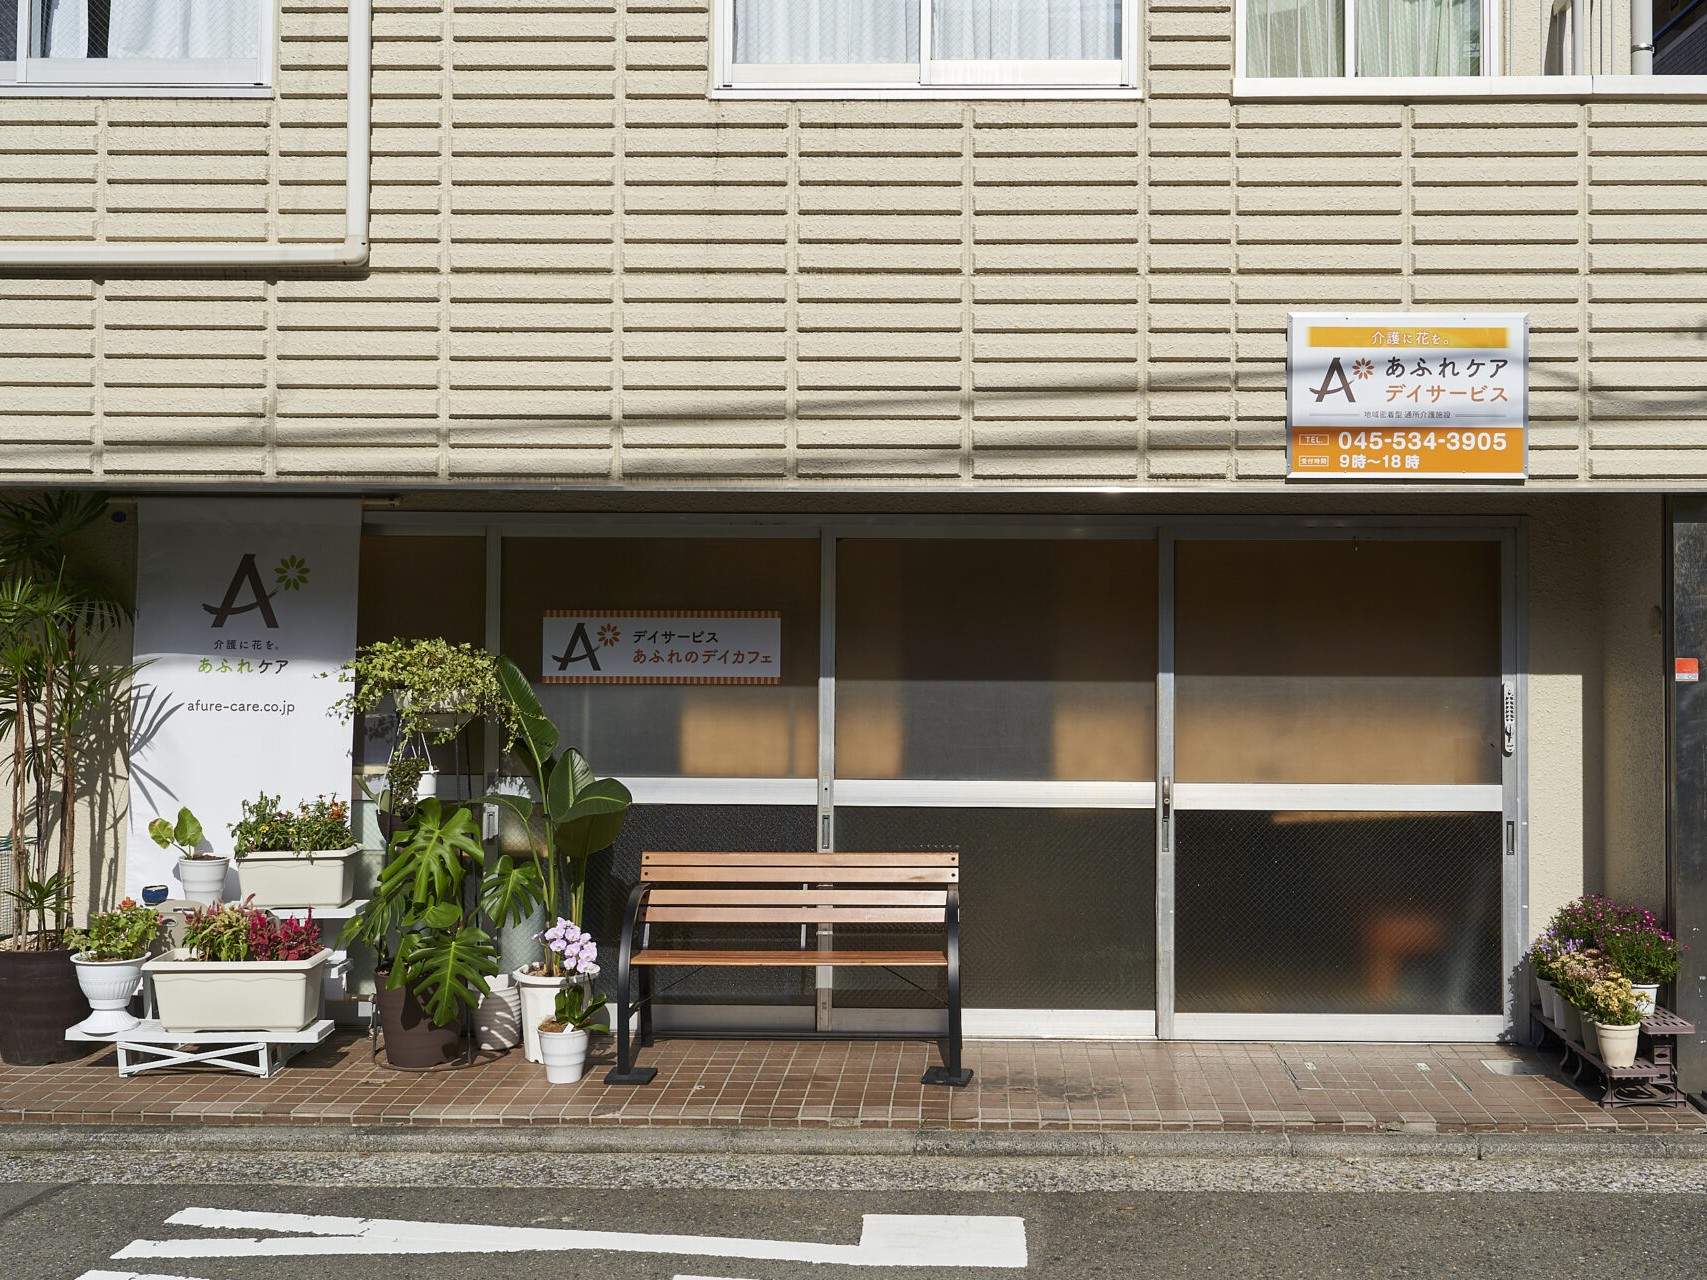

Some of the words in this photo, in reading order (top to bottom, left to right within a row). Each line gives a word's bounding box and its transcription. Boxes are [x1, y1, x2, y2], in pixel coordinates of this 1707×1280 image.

[1372, 331, 1450, 345] 介護に花を。
[1386, 356, 1509, 378] あふれケア
[1385, 384, 1508, 403] デイサービス
[1338, 431, 1507, 451] 045-534-3905
[213, 639, 279, 650] 介護に花を。
[632, 630, 719, 644] デイサービス
[632, 649, 772, 664] あふれのデイカフェ
[198, 658, 289, 675] あふれケア
[187, 700, 295, 716] afure-care.co.jp
